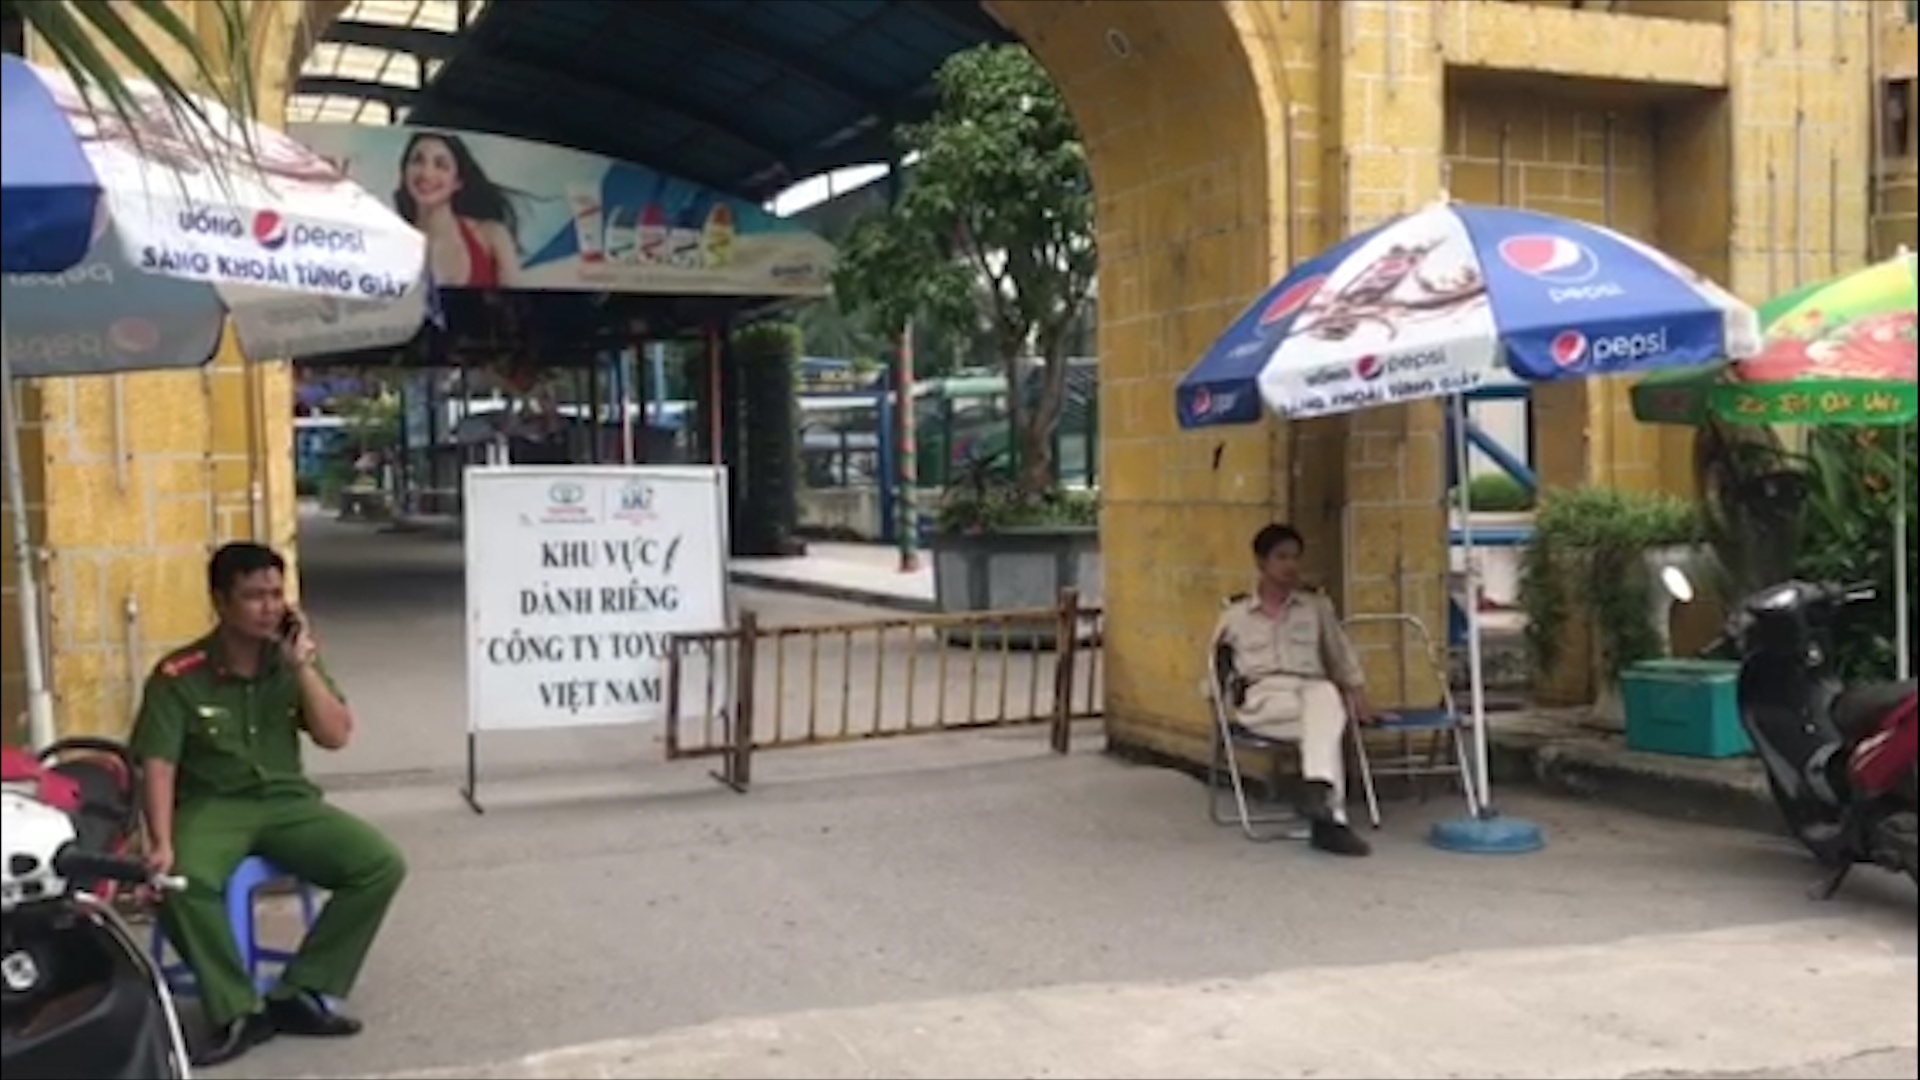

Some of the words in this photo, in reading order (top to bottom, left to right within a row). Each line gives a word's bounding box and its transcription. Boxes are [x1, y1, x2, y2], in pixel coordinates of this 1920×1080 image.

[293, 223, 366, 252] pepsi
[1548, 283, 1626, 303] pepsi
[1388, 348, 1447, 372] pepsi
[1593, 326, 1667, 366] pepsi
[541, 540, 597, 567] KHU
[604, 537, 659, 573] VỰC
[520, 581, 592, 615] DÀNH
[600, 577, 679, 613] RIÊNG
[488, 628, 563, 665] CÔNG
[569, 634, 601, 661] TY
[540, 677, 598, 714] VIỆT
[605, 678, 662, 704] NAM
